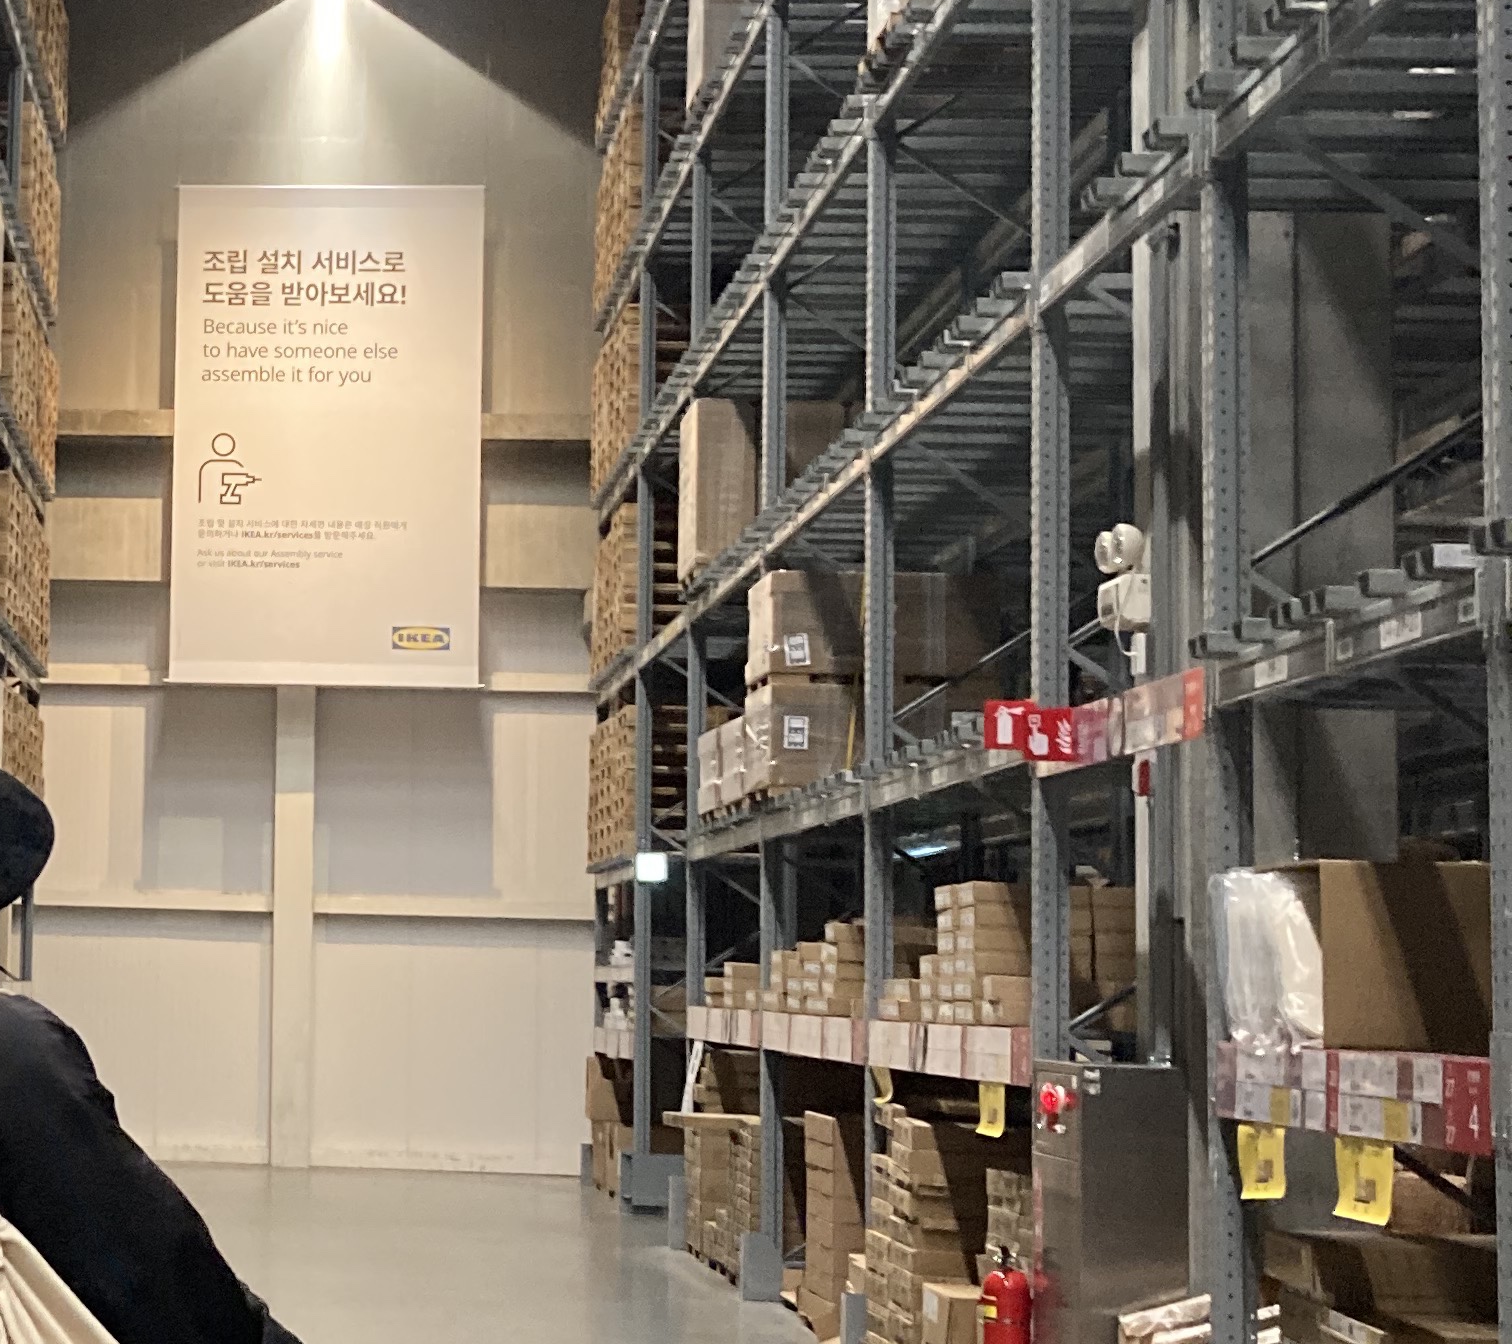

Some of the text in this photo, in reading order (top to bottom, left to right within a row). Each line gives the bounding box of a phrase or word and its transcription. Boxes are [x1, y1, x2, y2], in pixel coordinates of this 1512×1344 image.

[202, 248, 406, 276] 조립 설치 서비스로
[202, 280, 407, 307] 도움을 받아보세요!
[203, 317, 277, 335] Because
[313, 318, 348, 335] nice
[203, 341, 398, 359] to have someone else
[201, 365, 372, 387] assemble it for you
[1469, 1103, 1479, 1140] 4
